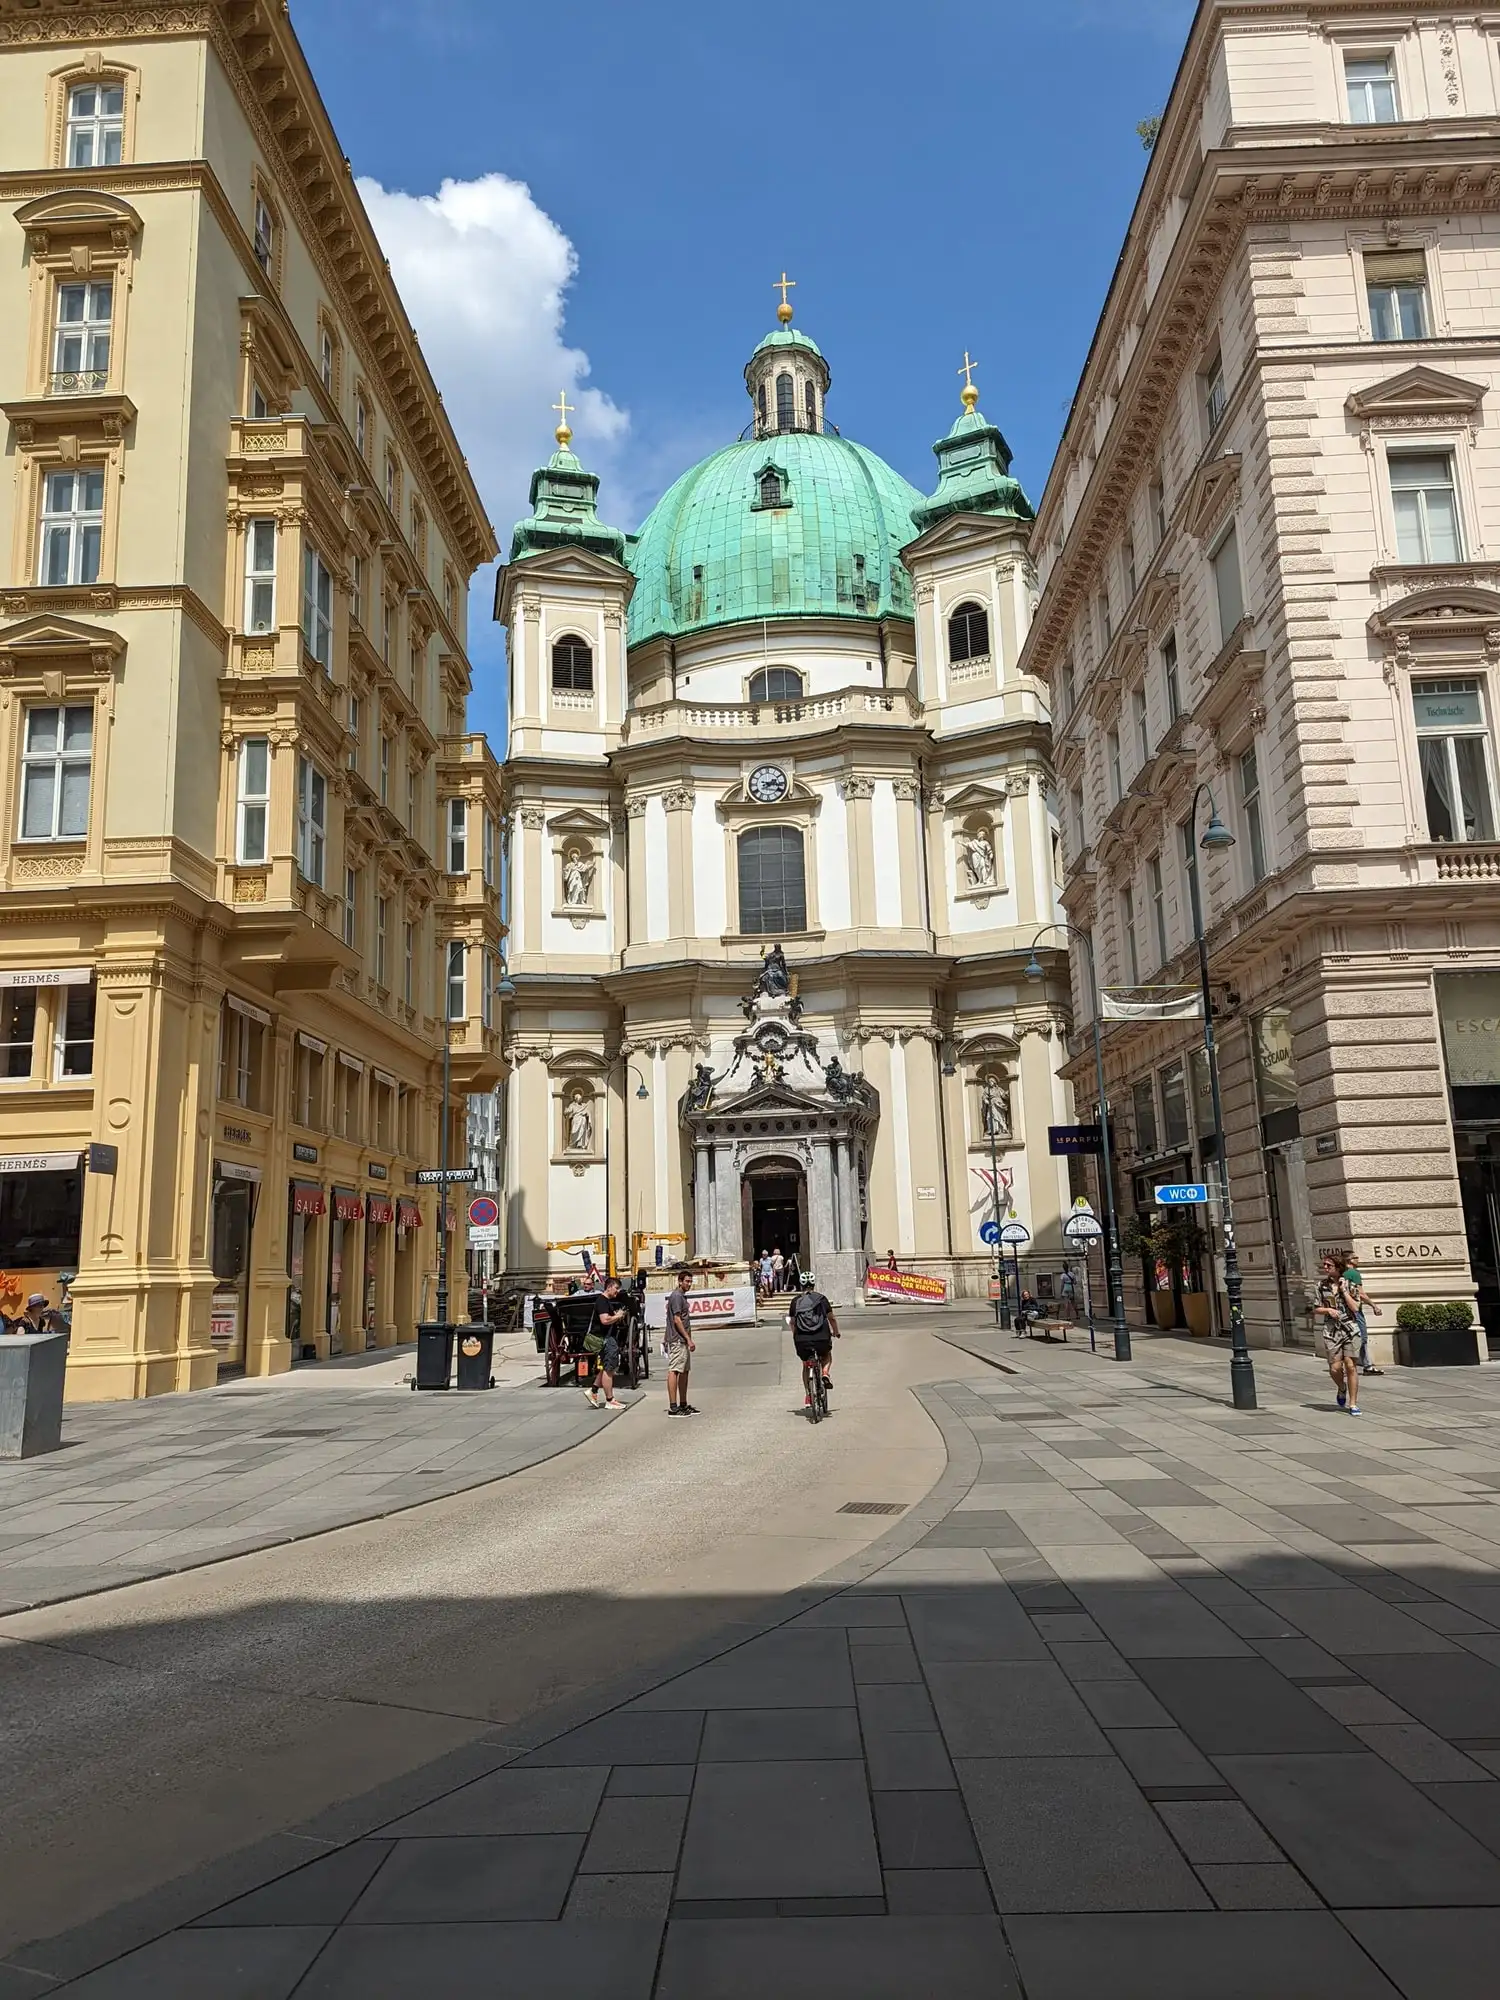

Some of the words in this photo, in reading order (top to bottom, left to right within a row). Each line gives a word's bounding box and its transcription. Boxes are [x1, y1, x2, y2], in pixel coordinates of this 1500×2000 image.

[1263, 1047, 1290, 1068] ESCADA
[1170, 1188, 1187, 1199] WC
[296, 1199, 320, 1214] SALE
[338, 1205, 358, 1220] SALE
[402, 1215, 419, 1227] SALE
[1374, 1245, 1442, 1258] ESCADA
[901, 1281, 914, 1289] DER
[915, 1283, 944, 1294] KIRCHEN
[902, 1275, 922, 1284] LANGE
[923, 1278, 944, 1287] NACHT
